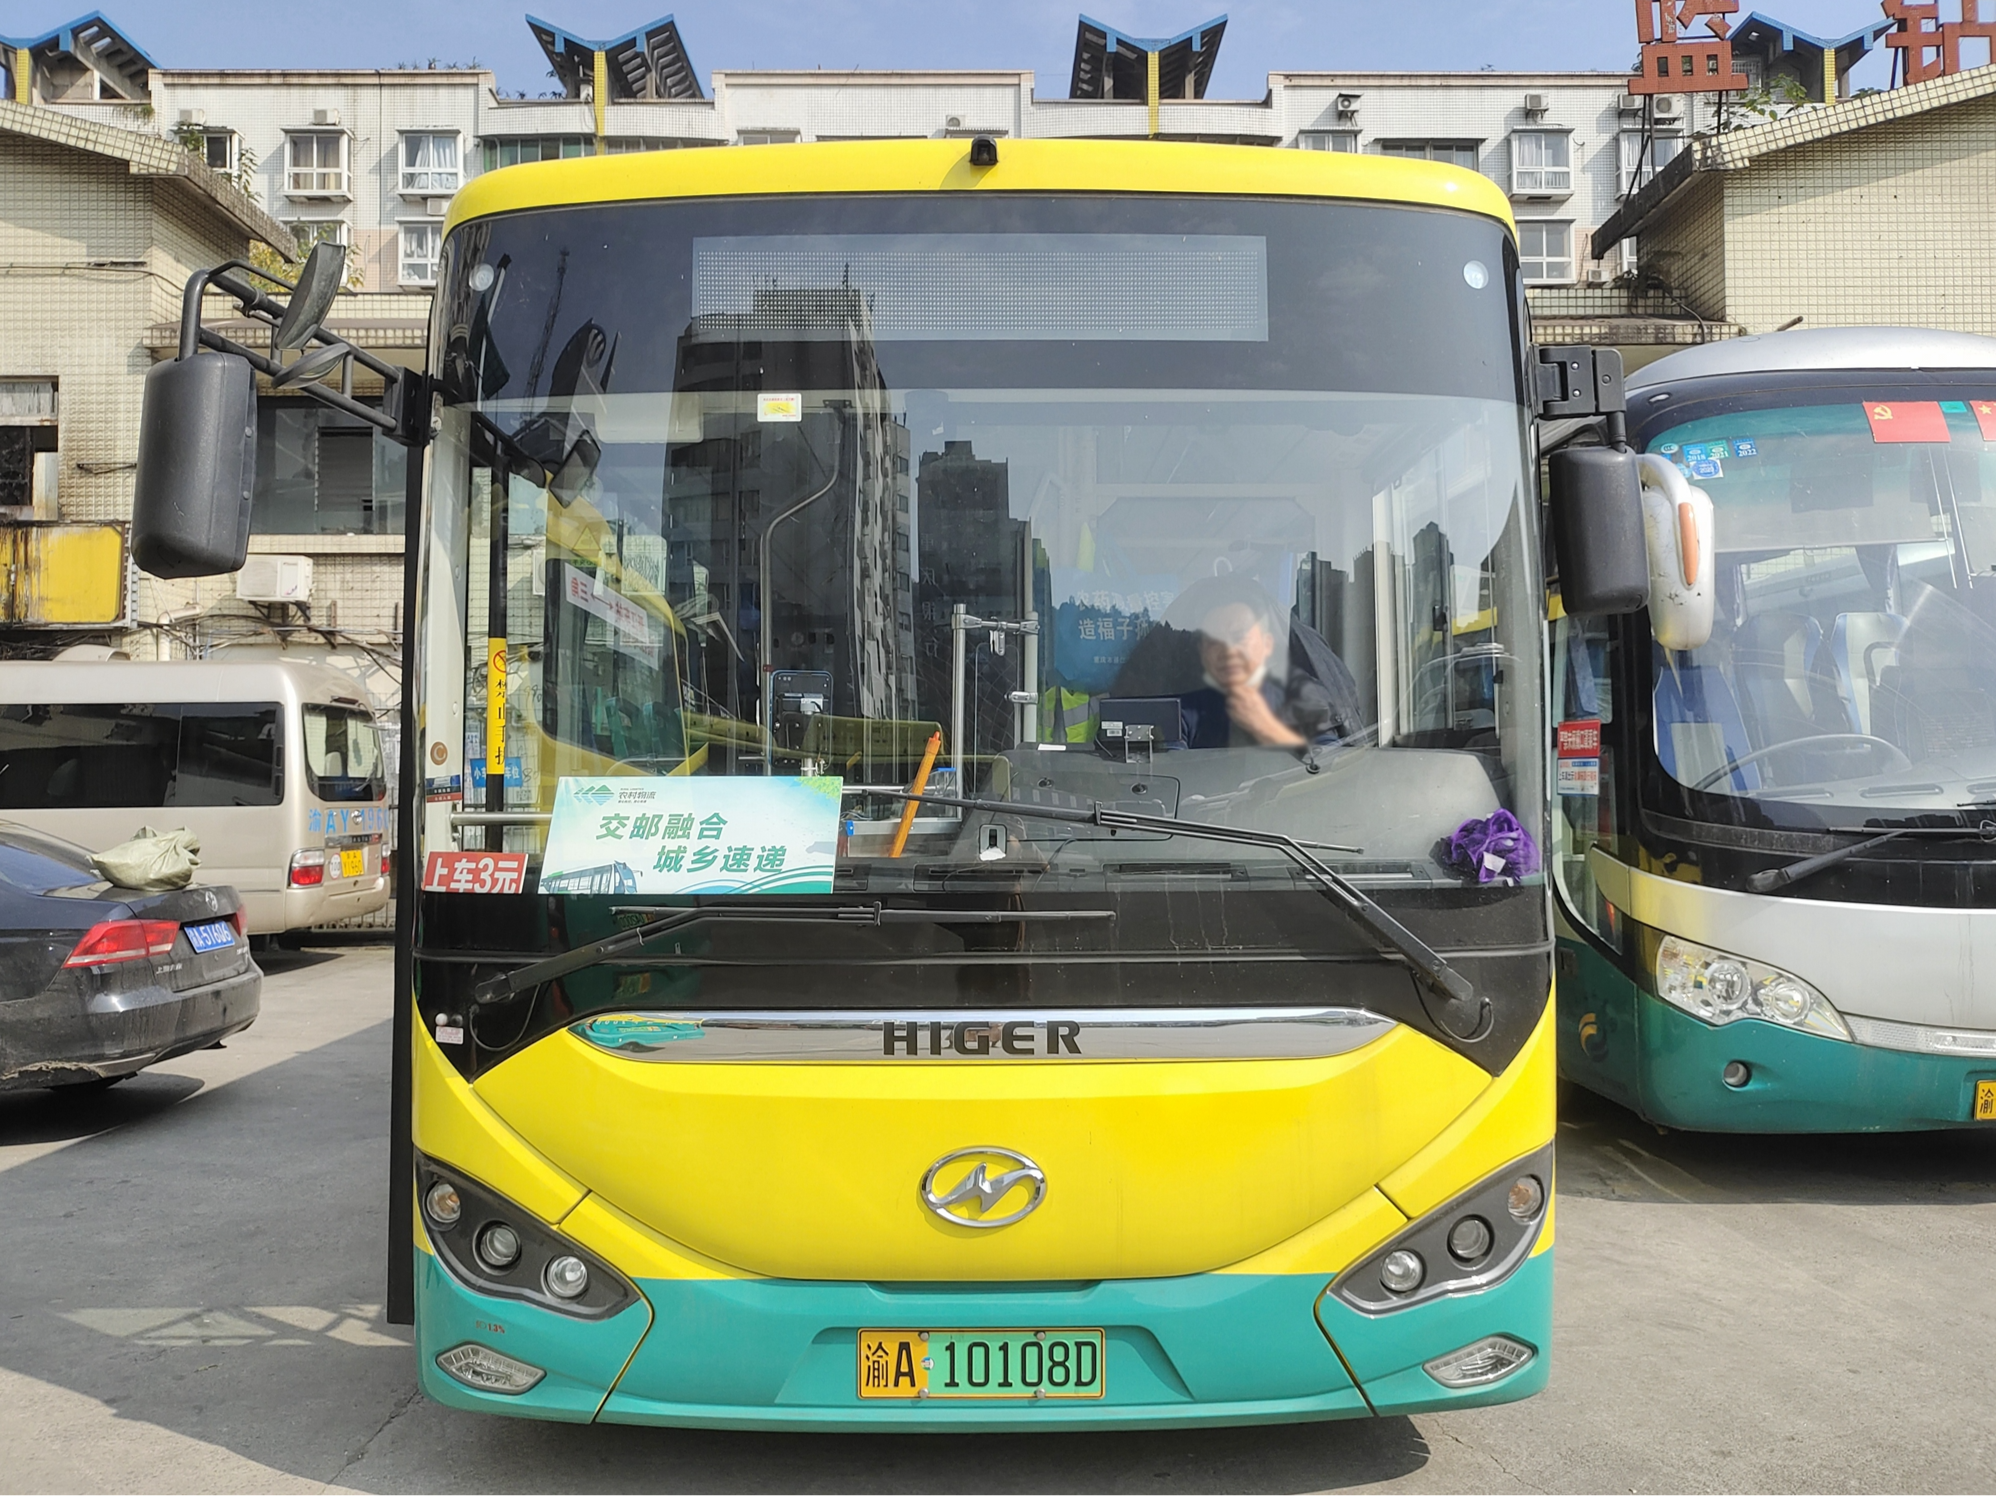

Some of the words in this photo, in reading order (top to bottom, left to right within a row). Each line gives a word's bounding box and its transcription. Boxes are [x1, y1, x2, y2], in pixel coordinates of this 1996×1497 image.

[618, 791, 657, 800] 农村物流
[595, 811, 729, 841] 交邮融合
[652, 844, 788, 874] 城乡速递
[424, 857, 519, 894] 上车3元
[882, 1020, 1083, 1056] HIGER
[1979, 1087, 1994, 1114] 渝
[865, 1340, 916, 1388] 渝A
[943, 1340, 1098, 1388] 10108D
